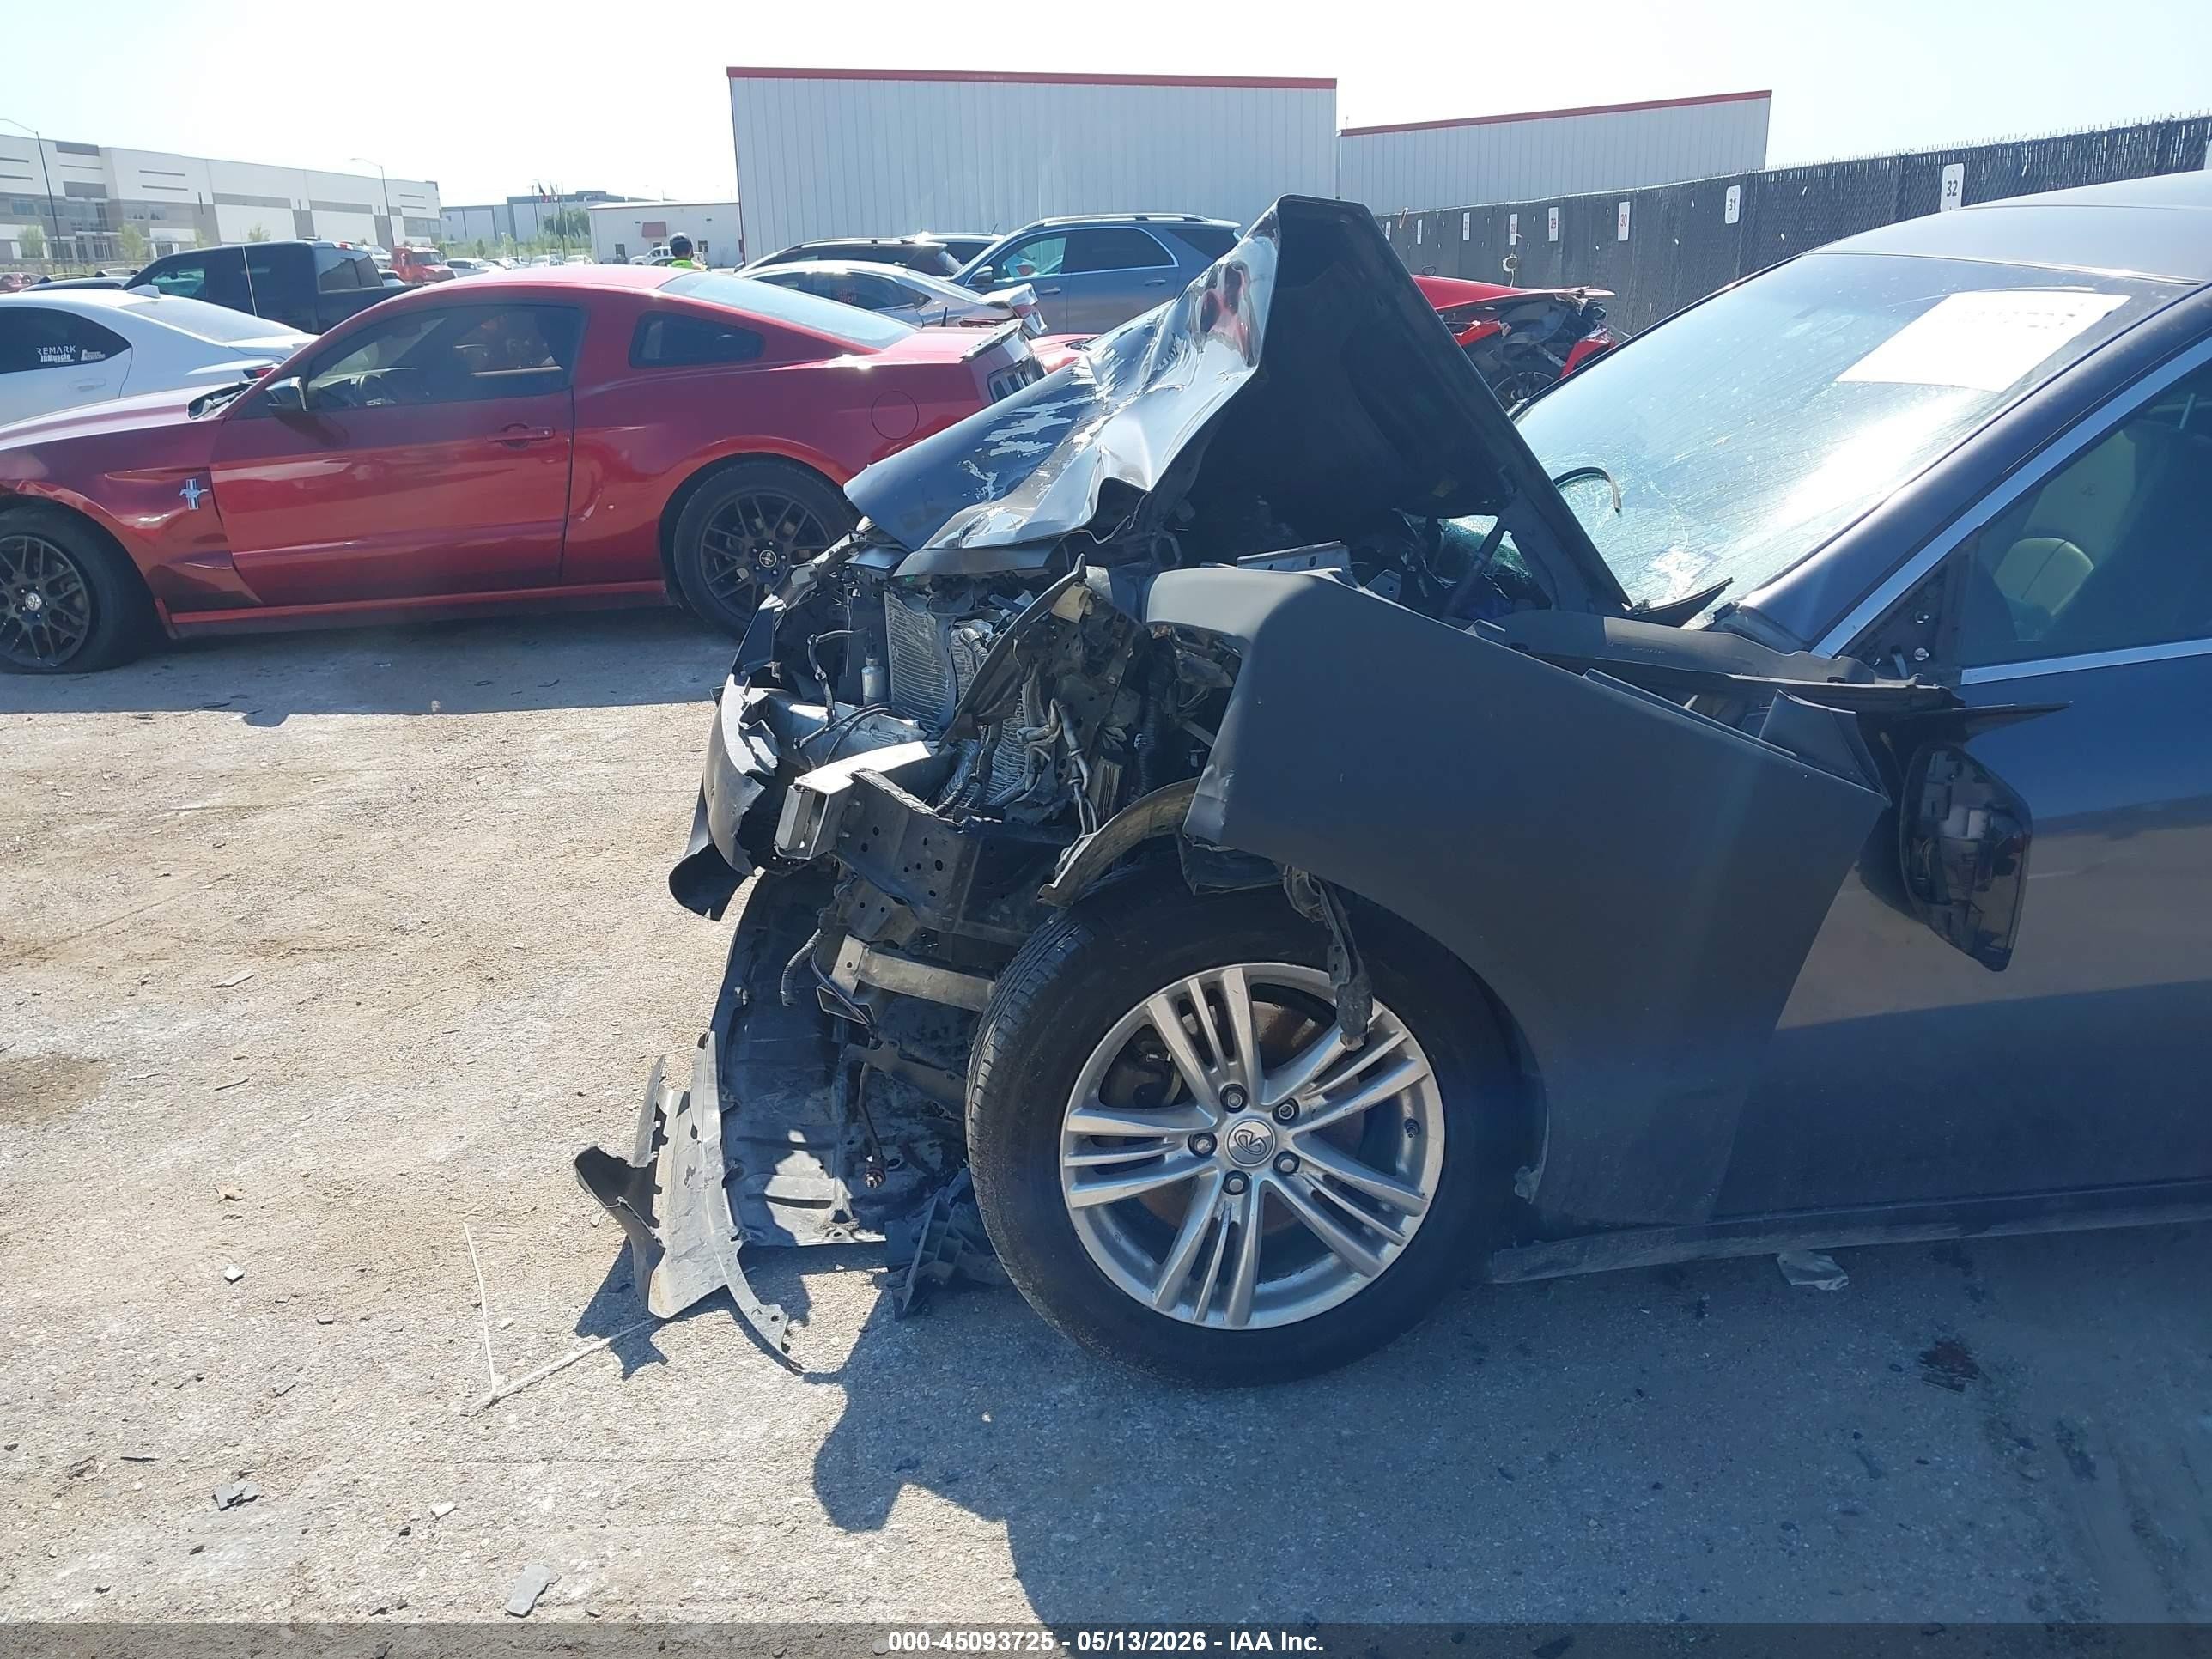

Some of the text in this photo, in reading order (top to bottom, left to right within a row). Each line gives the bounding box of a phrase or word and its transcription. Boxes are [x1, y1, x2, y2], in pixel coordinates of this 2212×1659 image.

[1946, 179, 1959, 198] 32
[1729, 198, 1737, 211] 31
[1620, 213, 1628, 228] 30
[35, 345, 76, 356] REMARK
